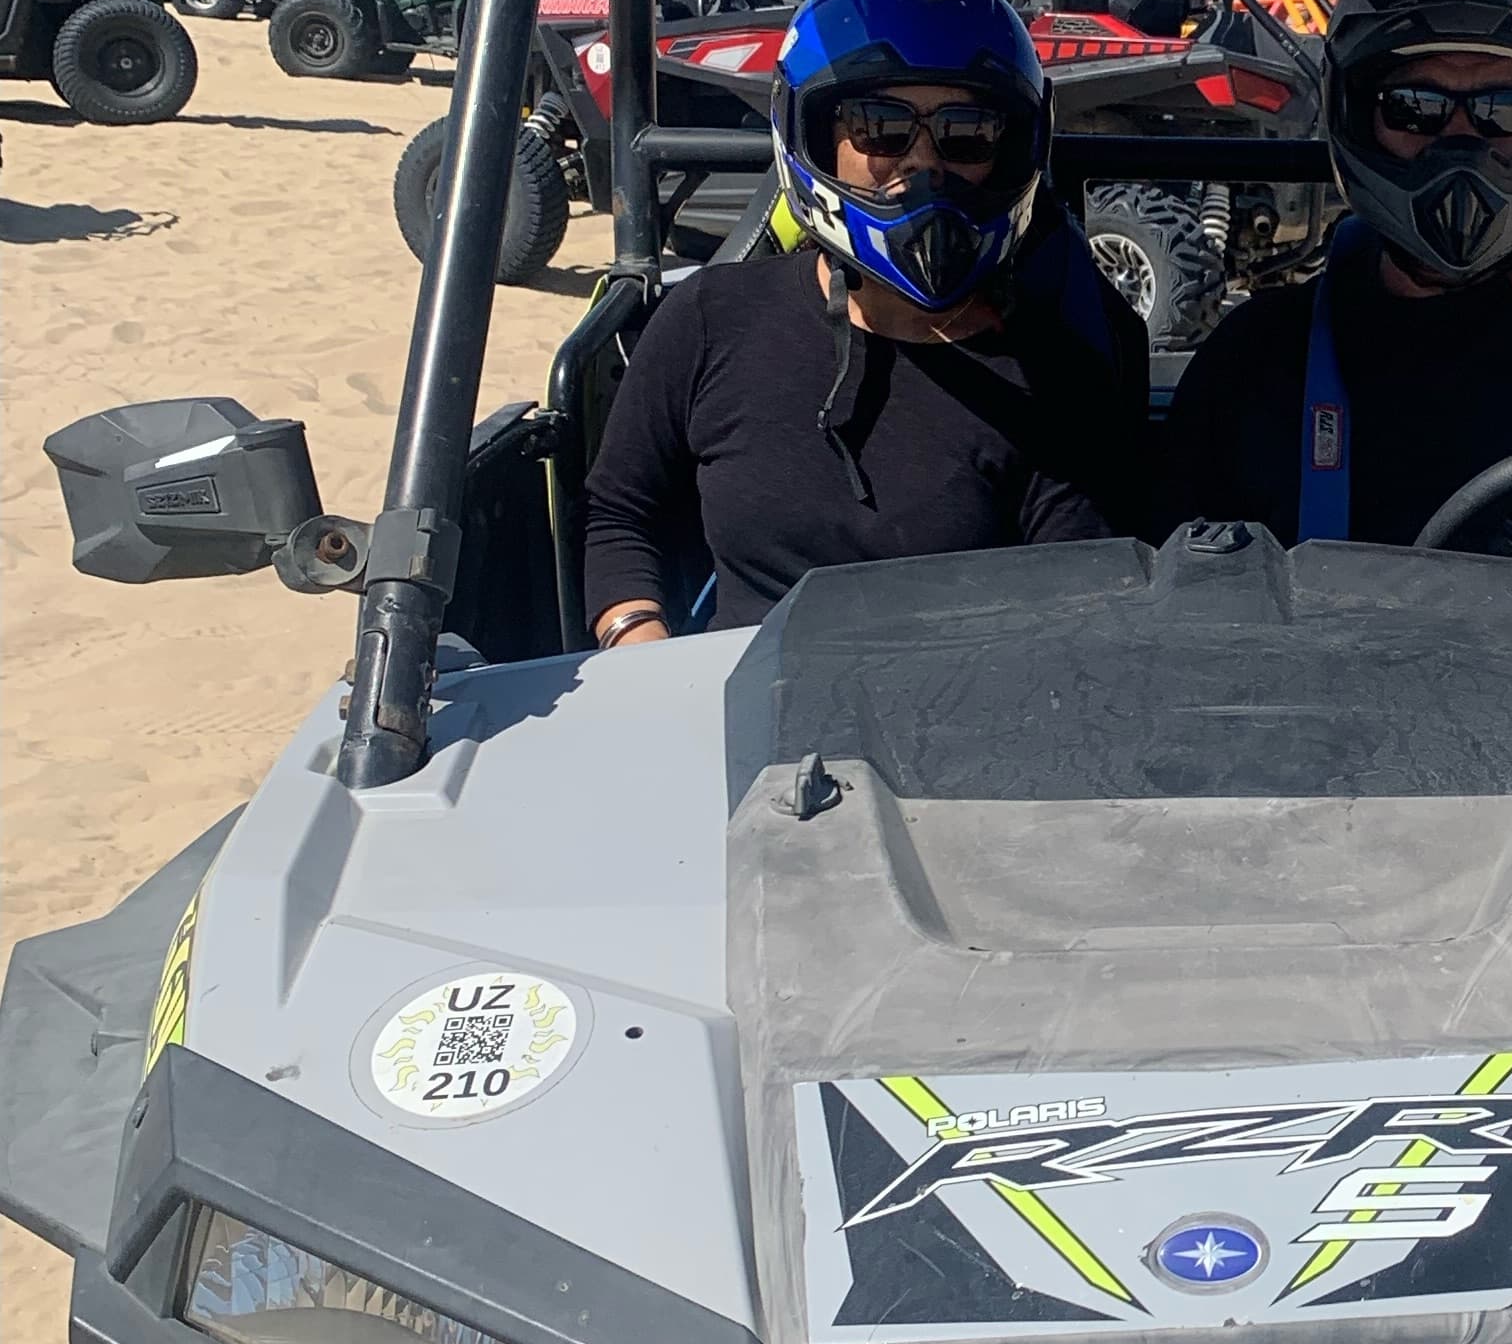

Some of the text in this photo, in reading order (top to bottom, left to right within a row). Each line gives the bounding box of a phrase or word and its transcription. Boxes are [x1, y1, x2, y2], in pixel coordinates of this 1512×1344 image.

[447, 983, 516, 1012] UZ
[422, 1068, 511, 1101] 210
[927, 1096, 1106, 1138] POLARIS
